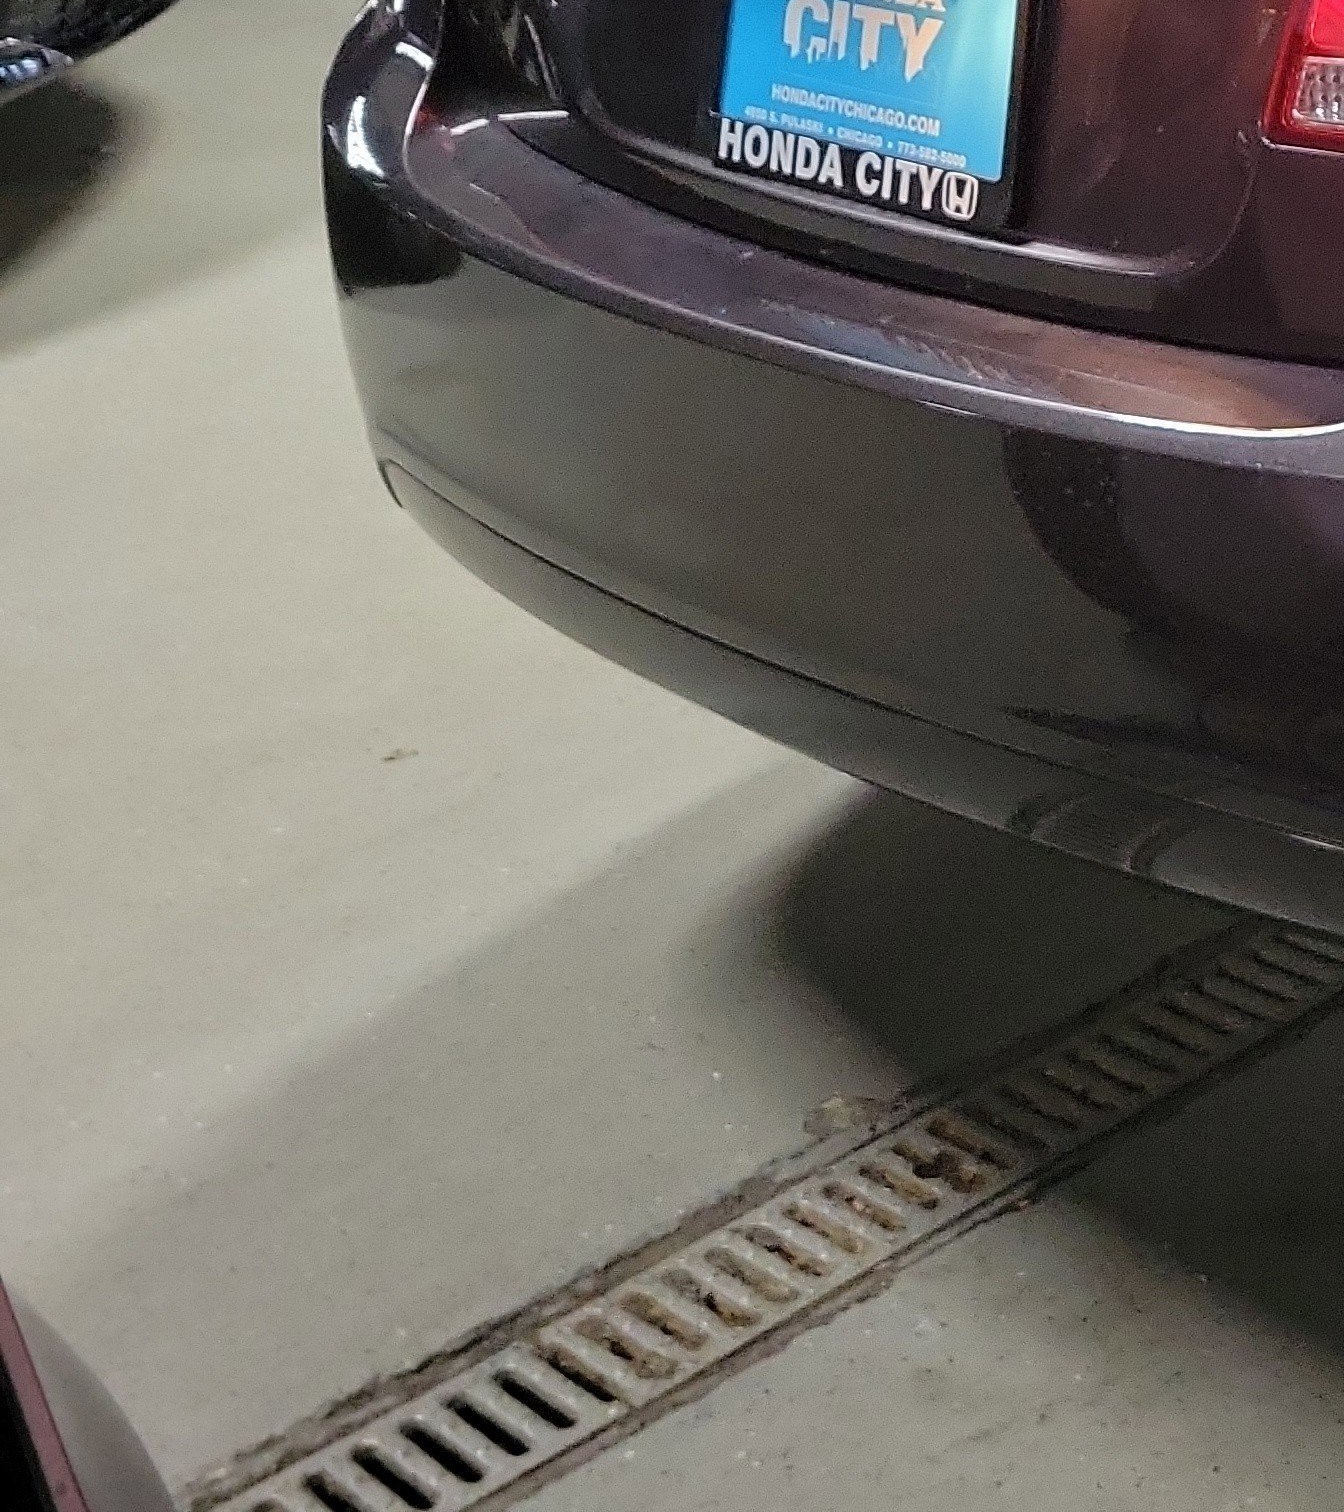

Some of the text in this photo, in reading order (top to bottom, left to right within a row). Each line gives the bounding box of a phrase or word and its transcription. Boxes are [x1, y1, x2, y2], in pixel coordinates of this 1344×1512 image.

[771, 83, 941, 138] HONDACITYCHICAGO.COM
[717, 117, 845, 188] HONDA
[854, 151, 944, 211] CITY
